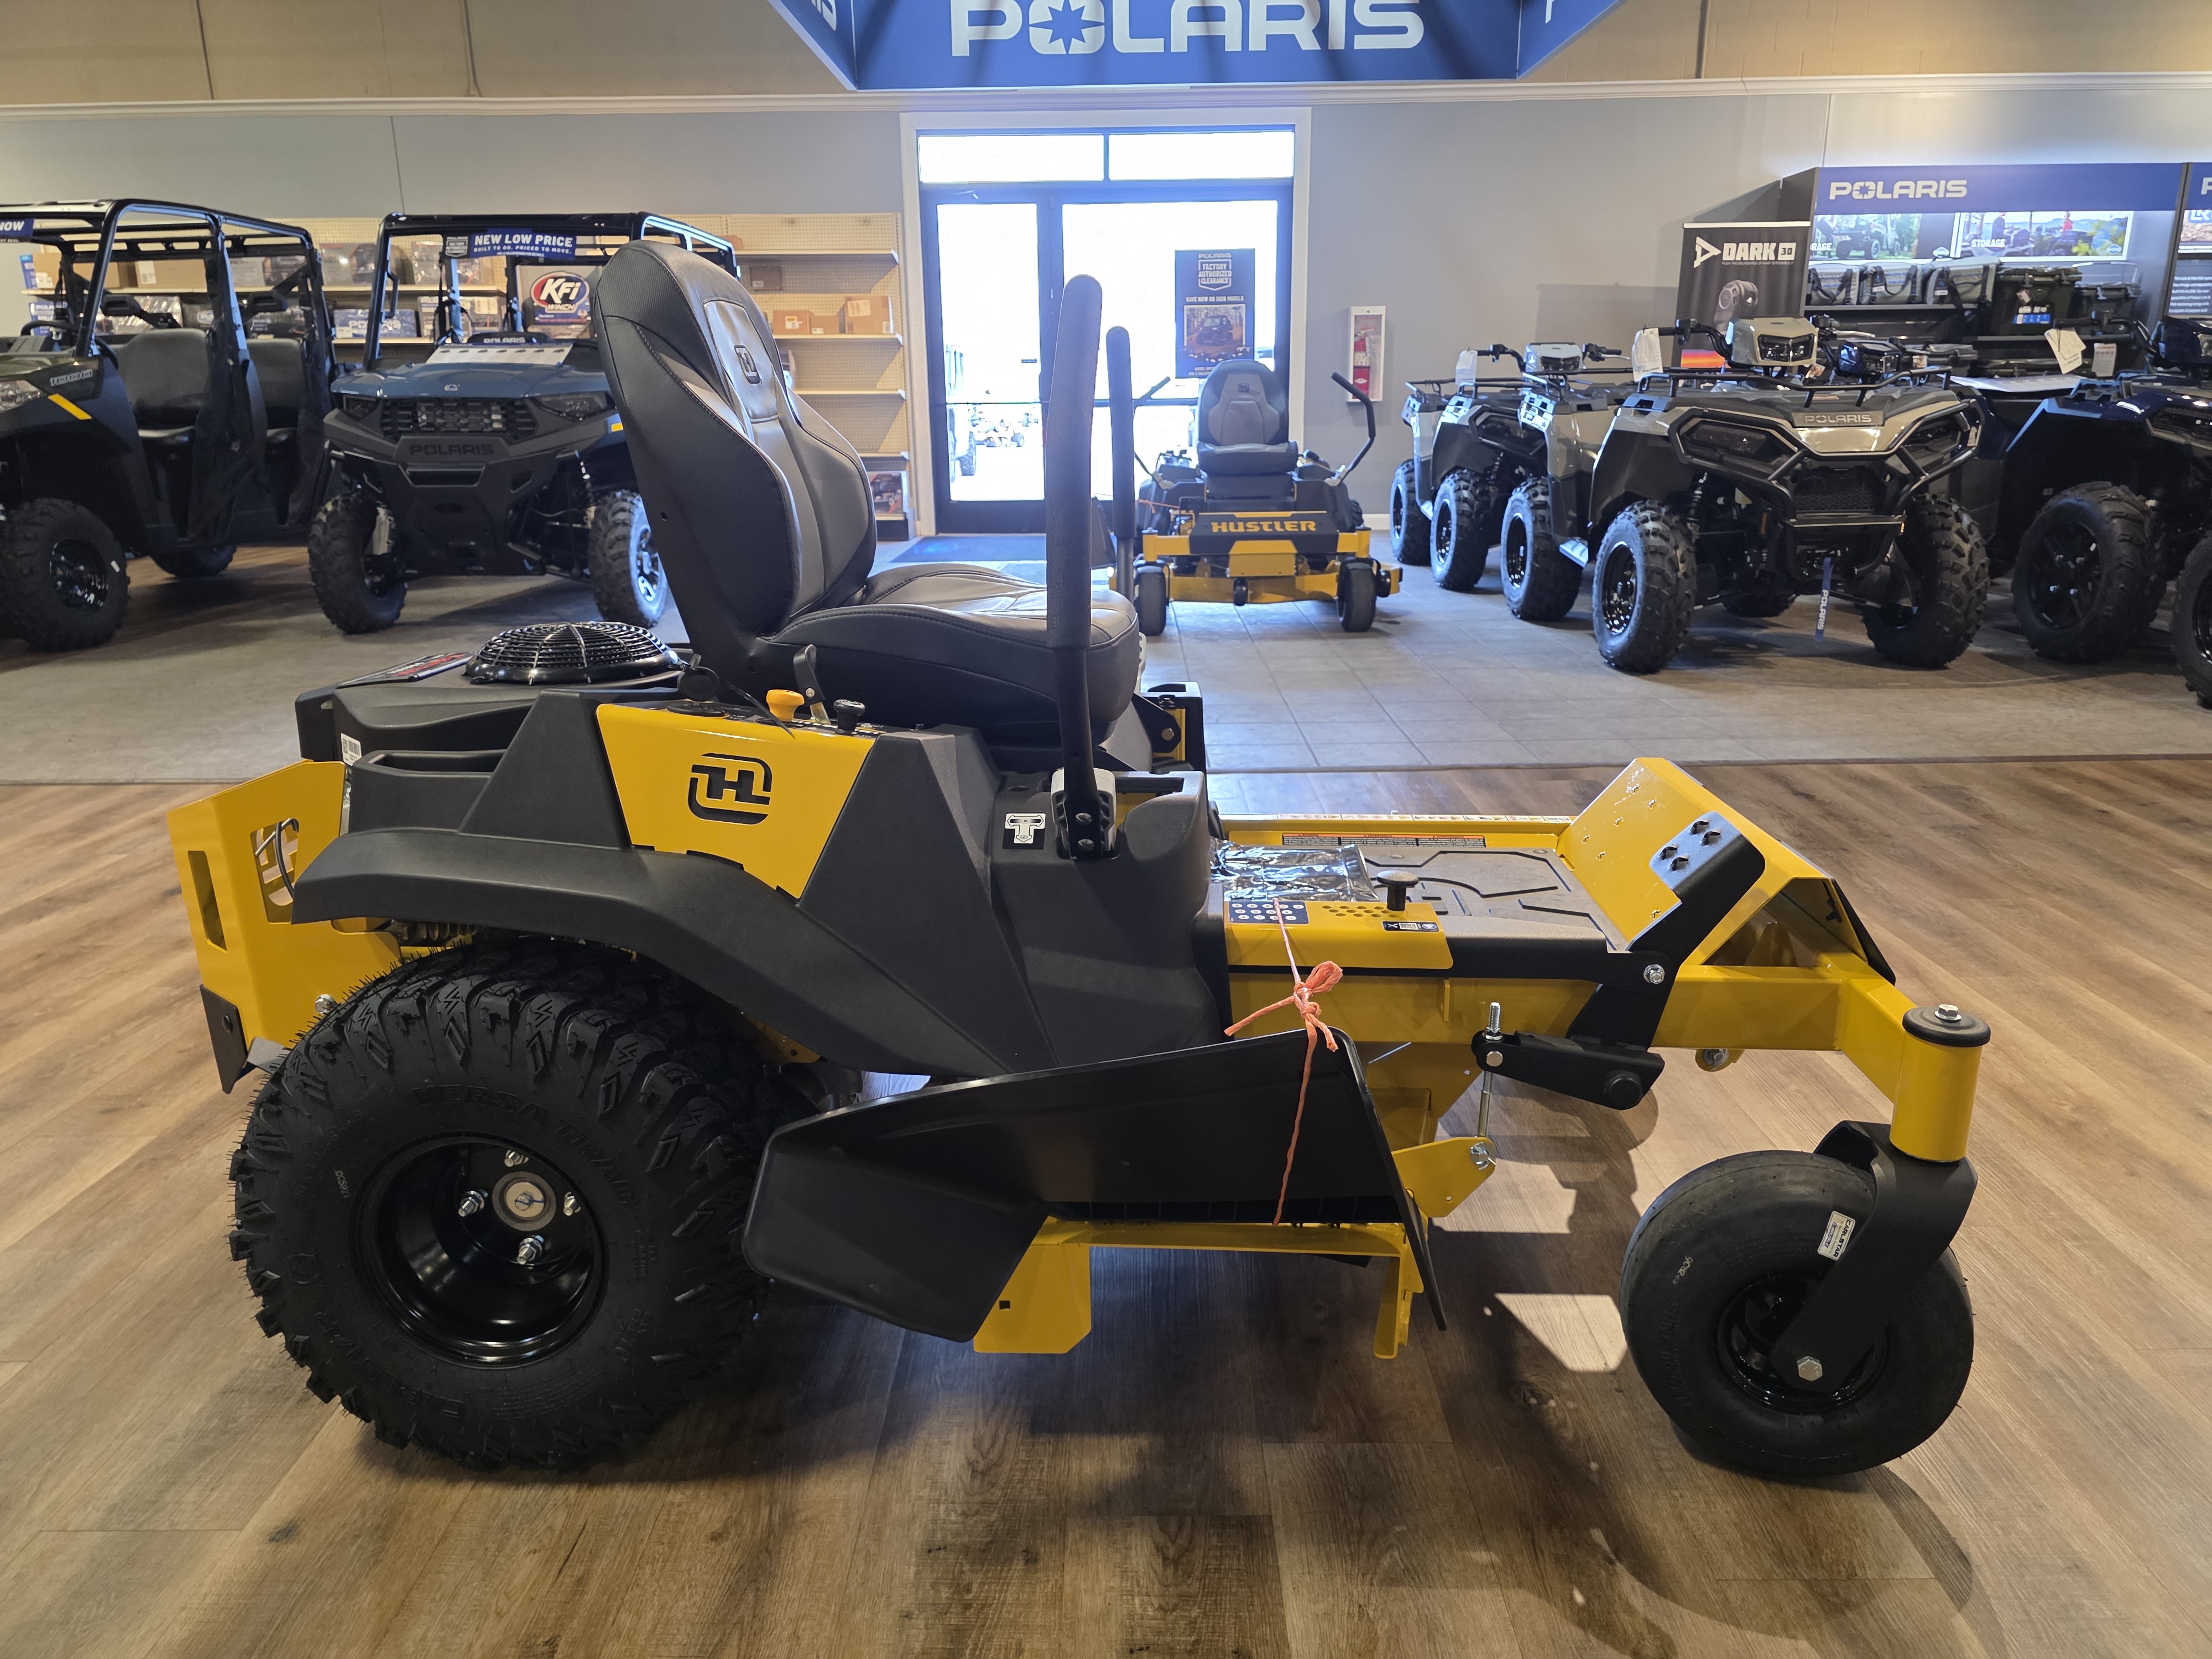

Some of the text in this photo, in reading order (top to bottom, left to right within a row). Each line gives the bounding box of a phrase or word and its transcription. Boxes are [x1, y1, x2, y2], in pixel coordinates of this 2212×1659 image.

[952, 0, 1425, 56] POLARIS
[1829, 180, 1968, 200] POLARIS
[474, 234, 502, 246] NEW
[504, 234, 533, 244] LOW
[534, 234, 573, 247] PRICE
[1810, 242, 1833, 251] RAGE
[1971, 238, 2006, 248] STORAGE
[1722, 242, 1777, 260] DARK
[1804, 415, 1872, 424] POLARIS
[410, 444, 494, 455] POLARIS
[1211, 521, 1317, 533] HUSTLER
[1817, 589, 1829, 630] POLARIS
[412, 1083, 547, 1123] VERSA
[1833, 1219, 1851, 1258] CARLSTAR
